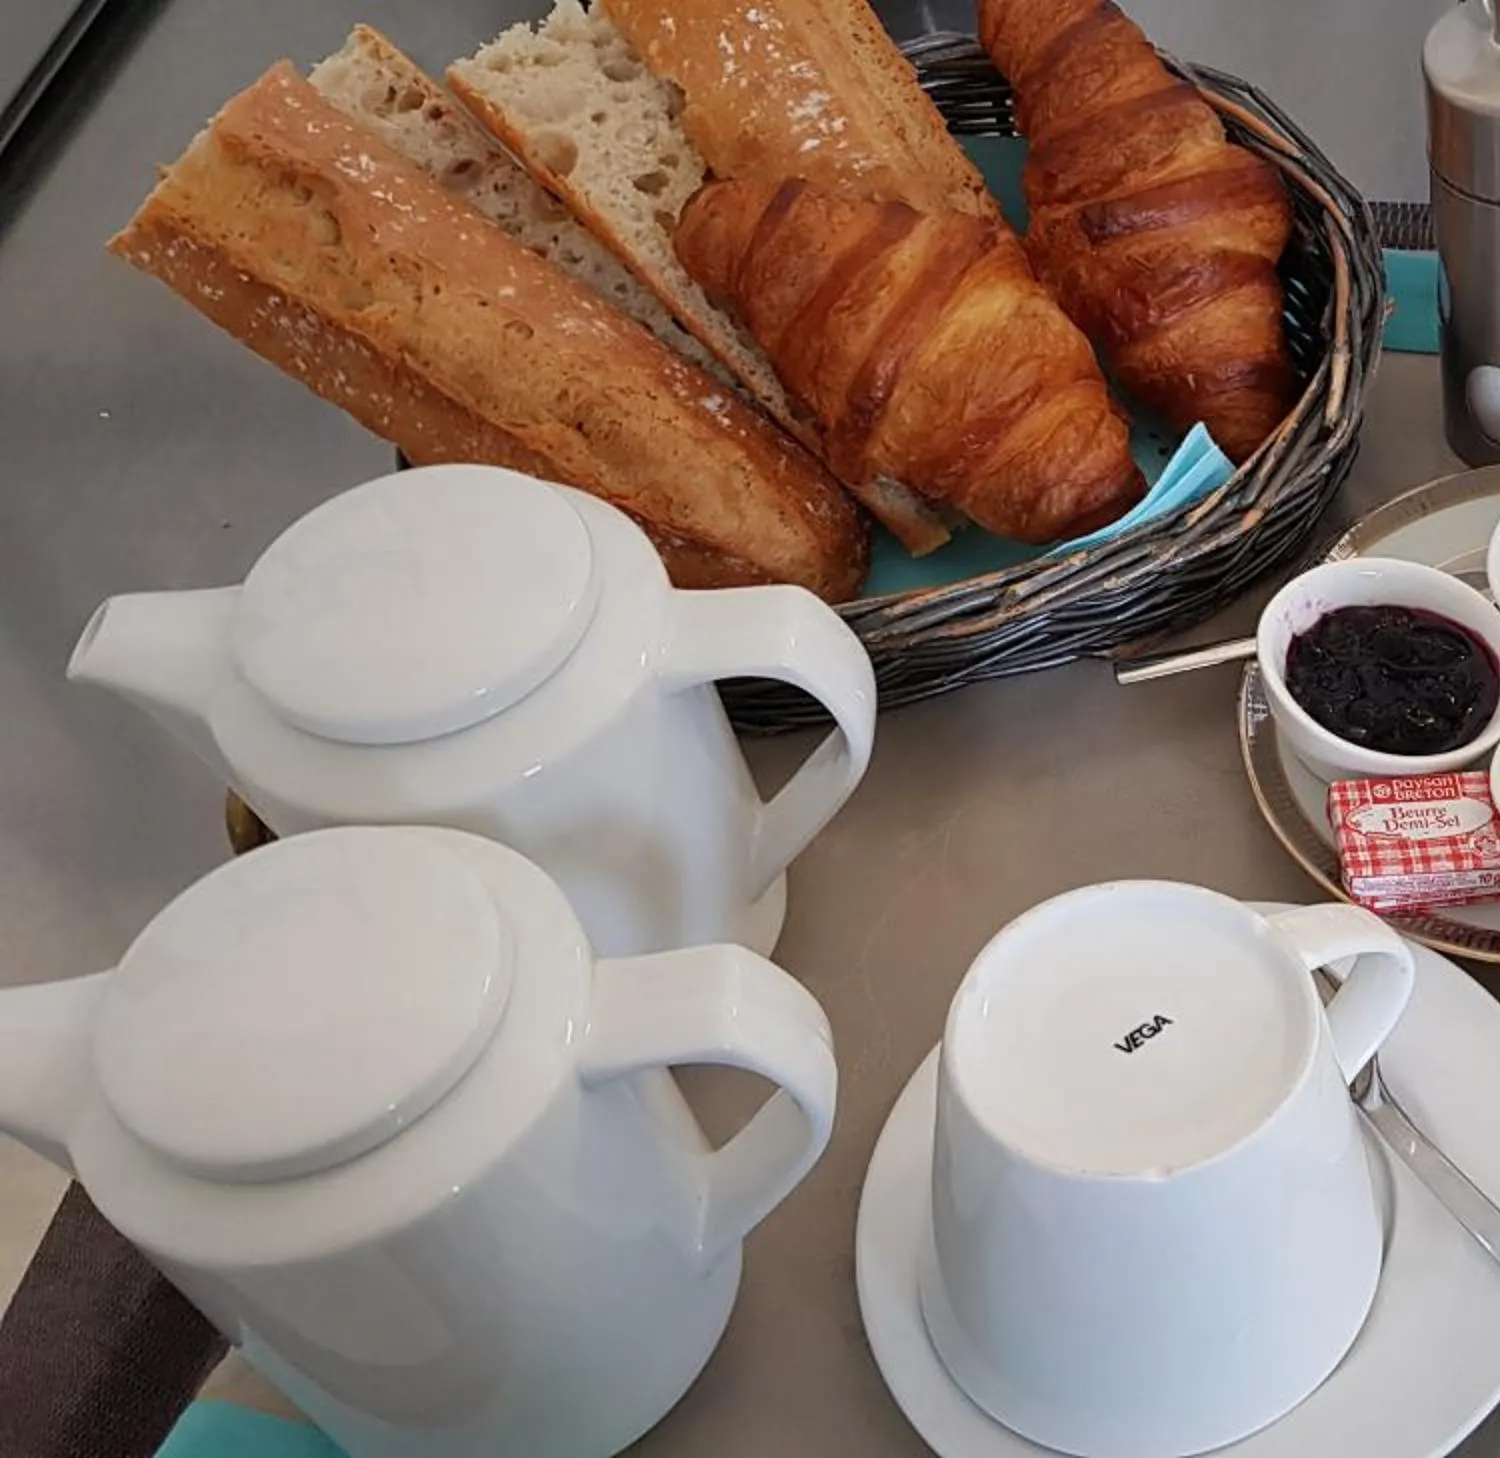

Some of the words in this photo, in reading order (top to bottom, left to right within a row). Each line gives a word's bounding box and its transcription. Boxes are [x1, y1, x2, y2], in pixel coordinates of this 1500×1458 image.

[1387, 807, 1448, 819] Beurre
[1383, 815, 1461, 832] Demi-Sel
[1113, 1014, 1175, 1054] VEGA
